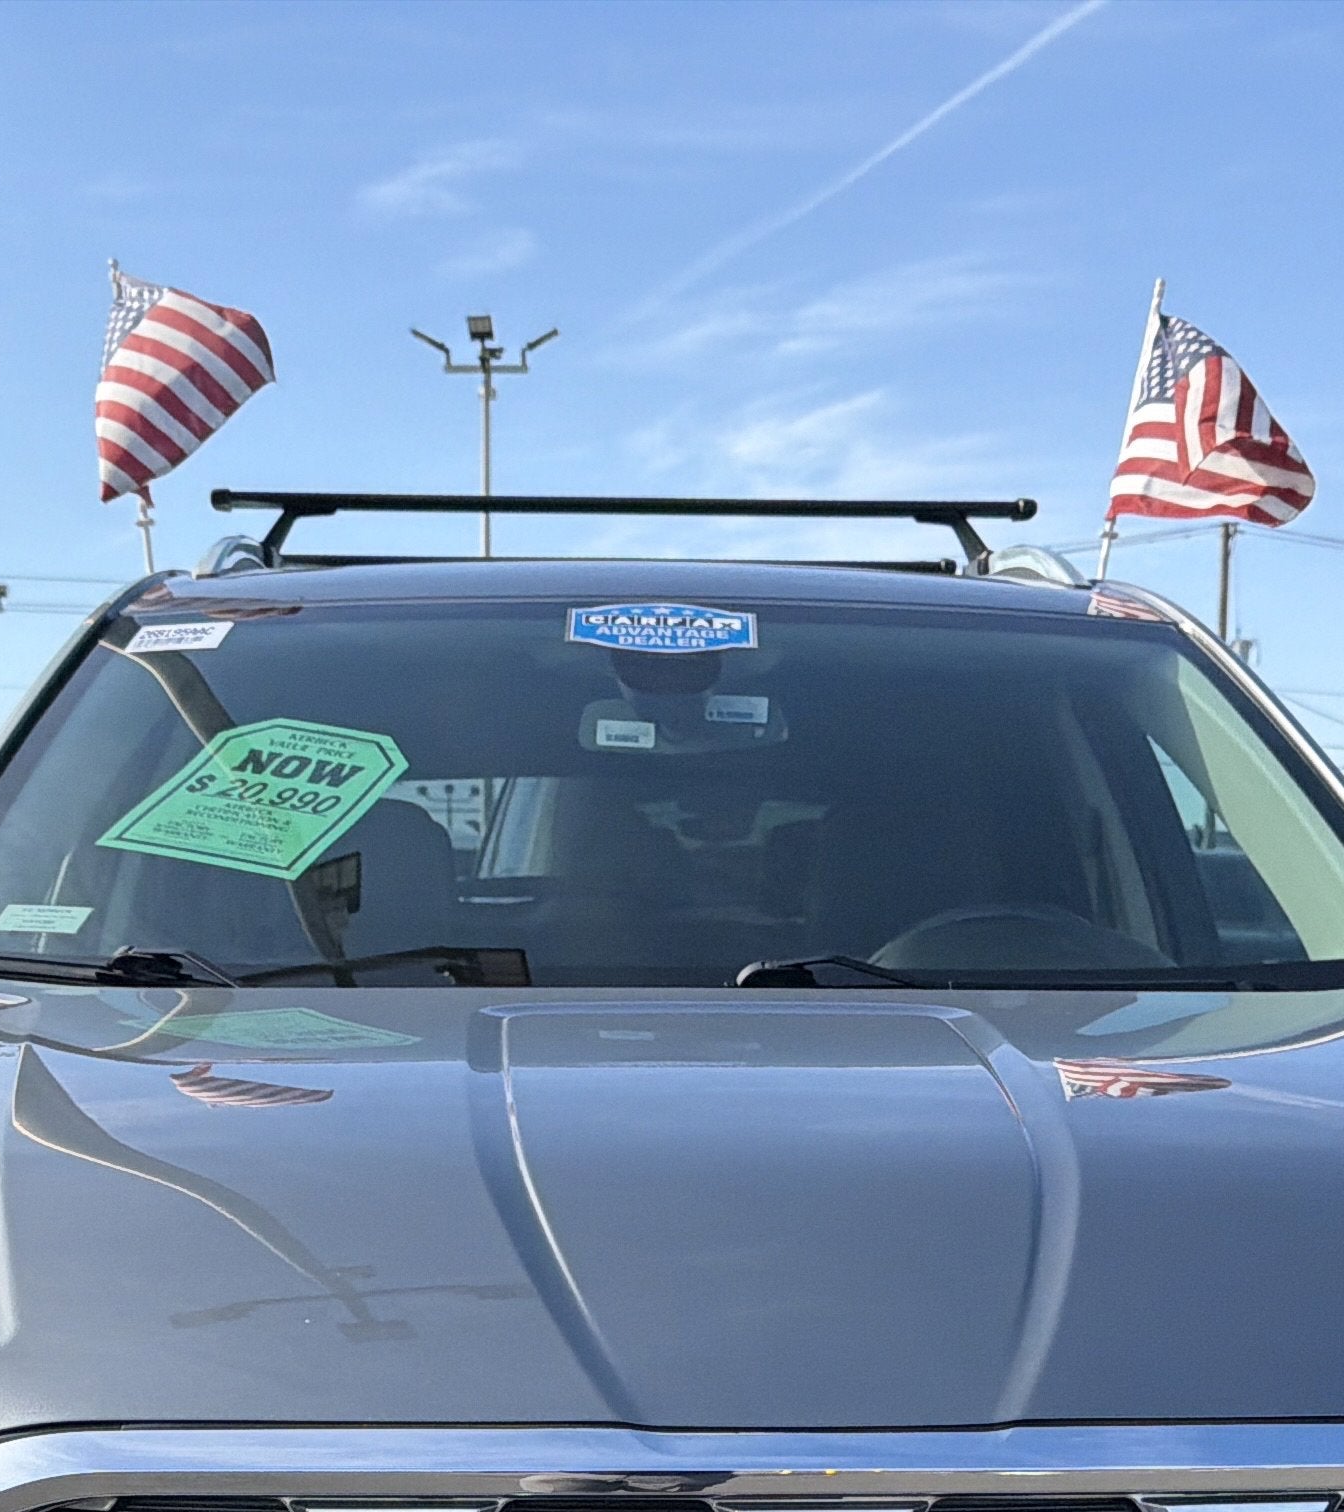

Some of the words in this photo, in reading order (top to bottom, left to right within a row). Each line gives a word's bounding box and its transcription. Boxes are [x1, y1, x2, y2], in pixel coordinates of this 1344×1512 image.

[585, 614, 742, 630] CARFAX
[596, 626, 729, 640] ADVANTAGE
[618, 636, 705, 647] DEALER
[231, 748, 365, 788] NOW
[186, 773, 215, 794] $
